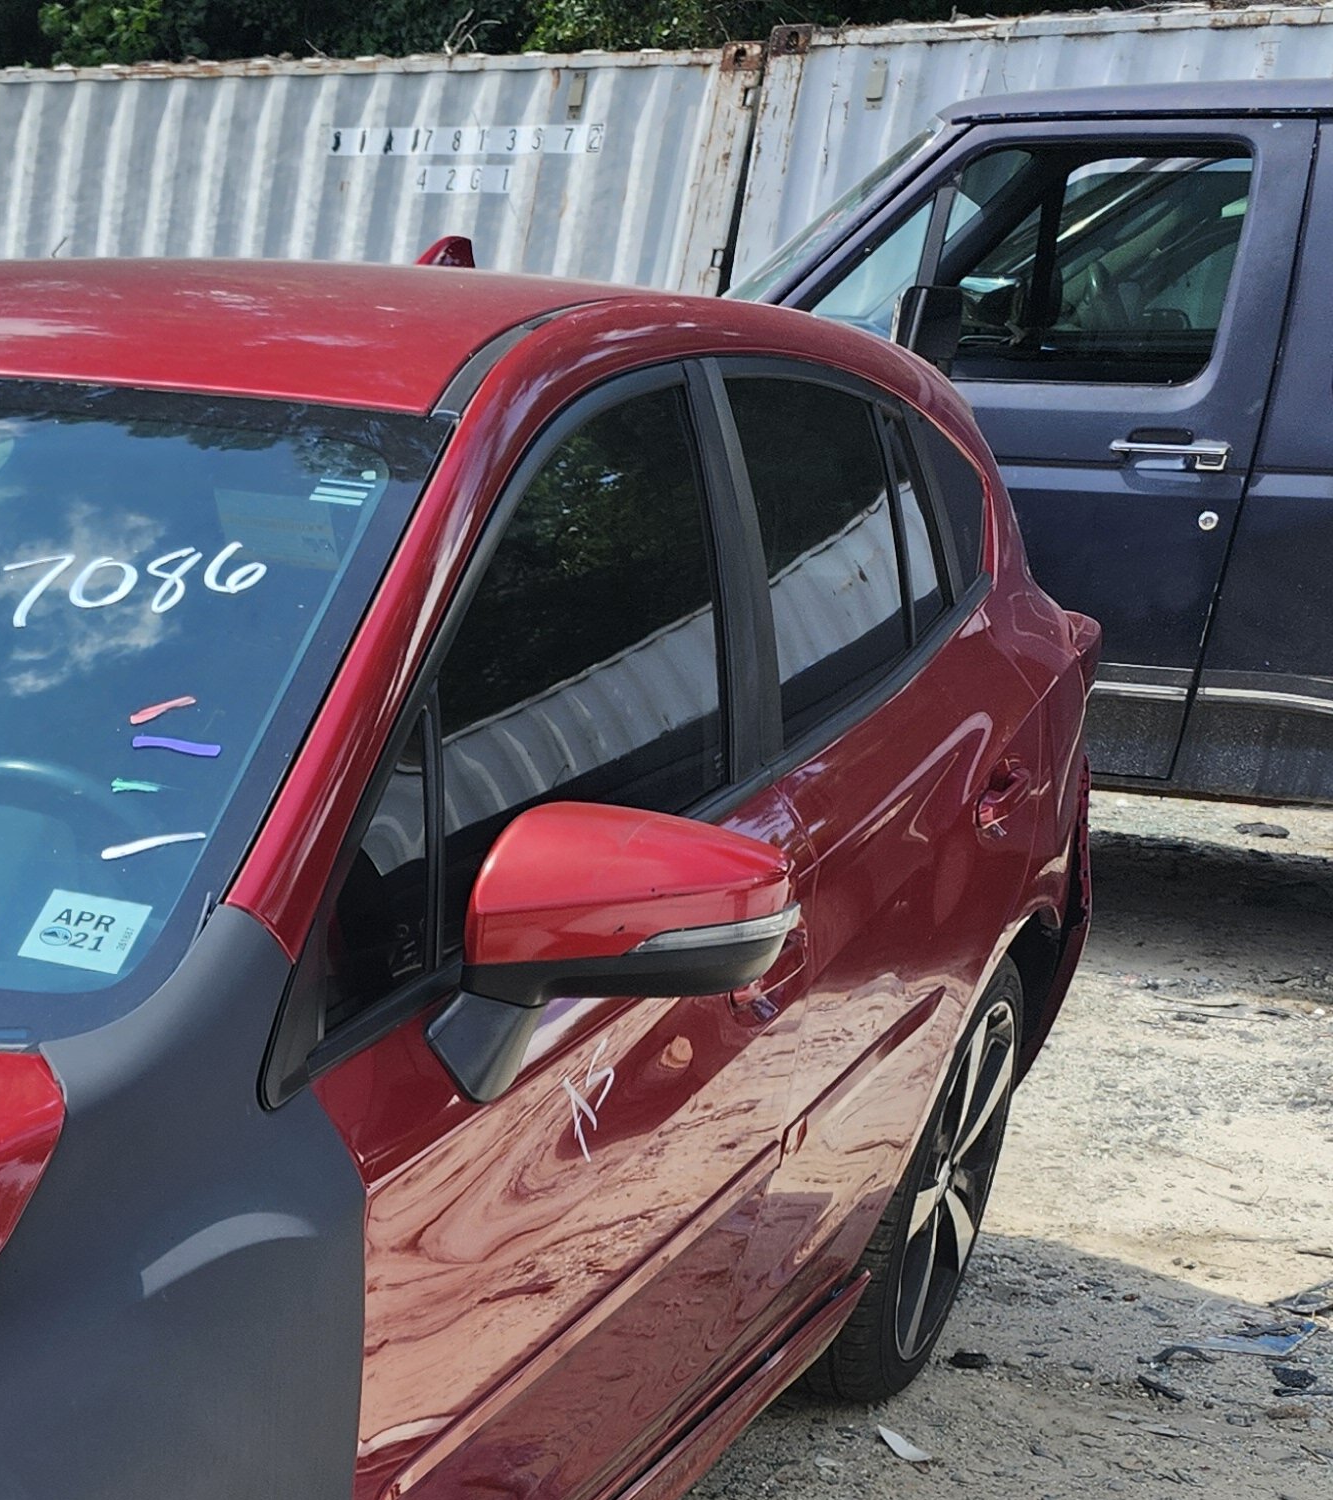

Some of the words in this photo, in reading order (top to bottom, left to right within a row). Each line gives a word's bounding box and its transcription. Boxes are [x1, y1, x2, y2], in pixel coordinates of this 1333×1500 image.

[2, 540, 268, 628] 7086
[52, 908, 116, 933] APR
[68, 932, 105, 952] 21
